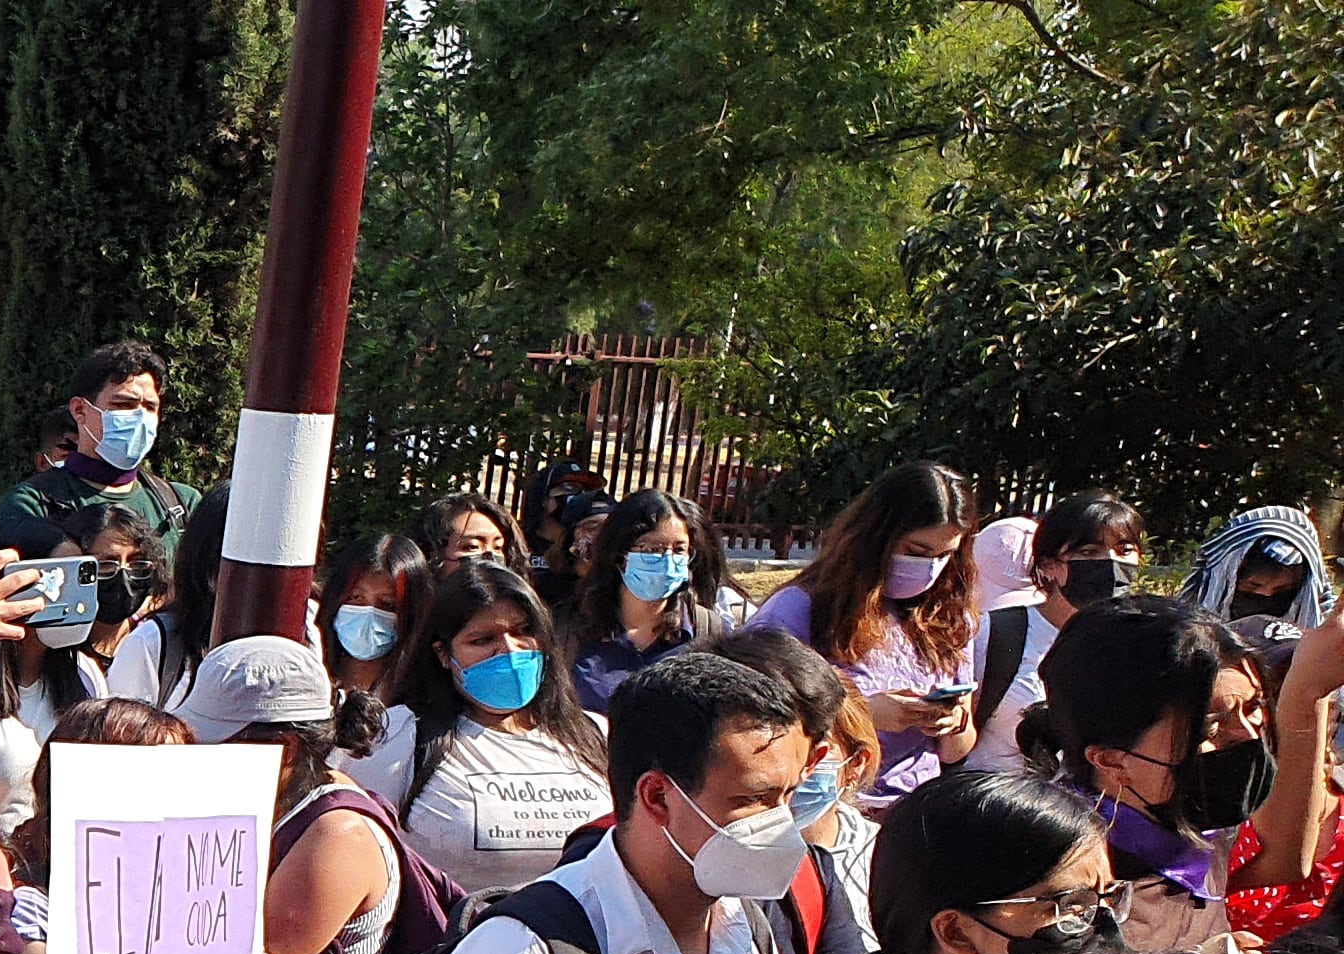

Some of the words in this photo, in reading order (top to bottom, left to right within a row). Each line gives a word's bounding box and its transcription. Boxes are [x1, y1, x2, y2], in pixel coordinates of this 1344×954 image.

[486, 780, 598, 803] Welcome
[514, 810, 530, 820] to
[534, 808, 560, 820] the
[563, 808, 592, 822] city
[488, 825, 524, 839] that
[211, 828, 248, 888] ME
